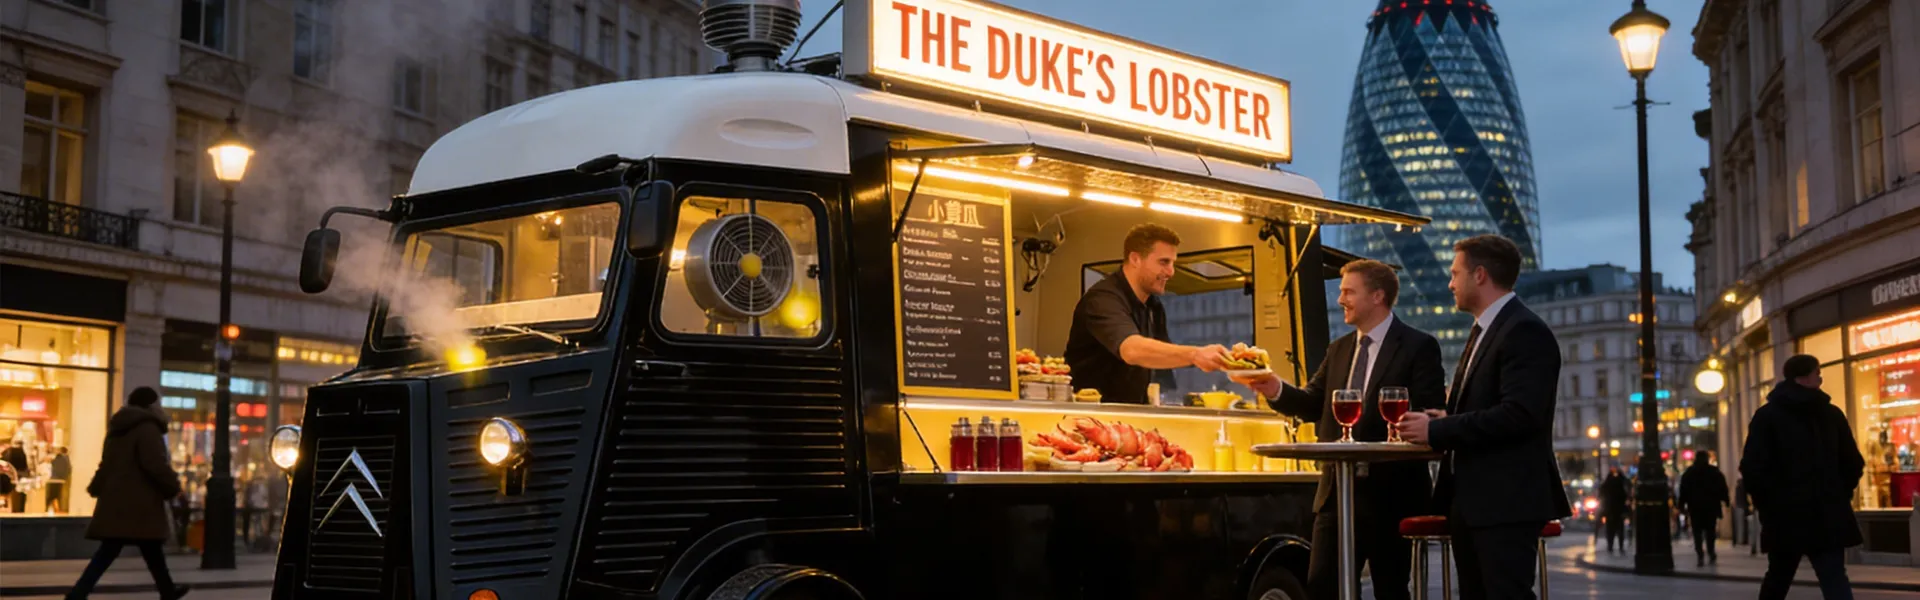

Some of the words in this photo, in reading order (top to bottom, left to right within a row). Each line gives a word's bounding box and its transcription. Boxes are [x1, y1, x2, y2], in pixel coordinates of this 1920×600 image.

[892, 1, 971, 73] THE
[988, 25, 1116, 104] DUKE'S
[1130, 61, 1272, 140] LOBSTER
